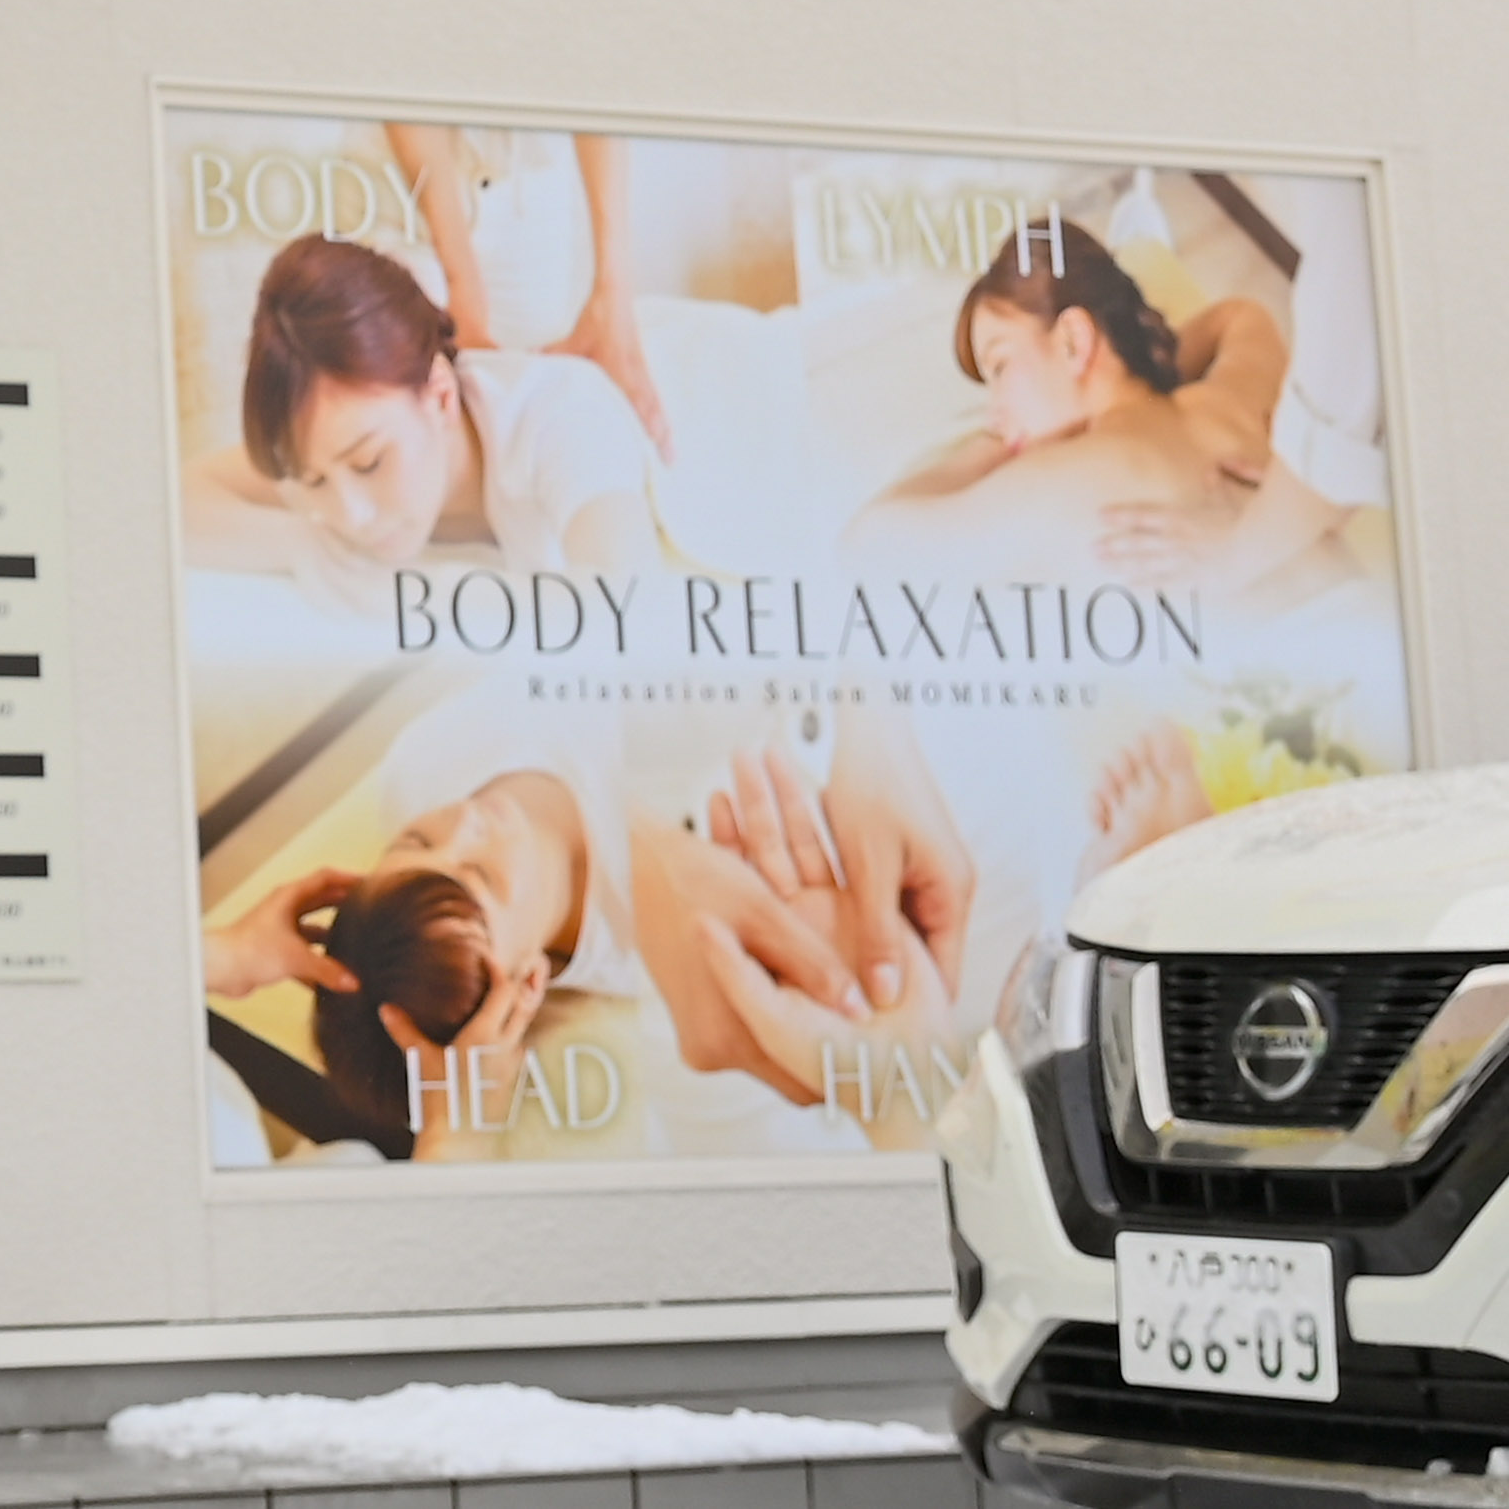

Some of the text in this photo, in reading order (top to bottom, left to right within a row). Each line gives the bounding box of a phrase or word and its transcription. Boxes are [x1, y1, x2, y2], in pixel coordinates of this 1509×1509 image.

[192, 152, 429, 243] BODY
[823, 189, 1065, 279] LYMPH
[394, 569, 1203, 667] BODY RELAXATION
[405, 1042, 623, 1133] HEAD
[1169, 1302, 1319, 1383] 66-09
